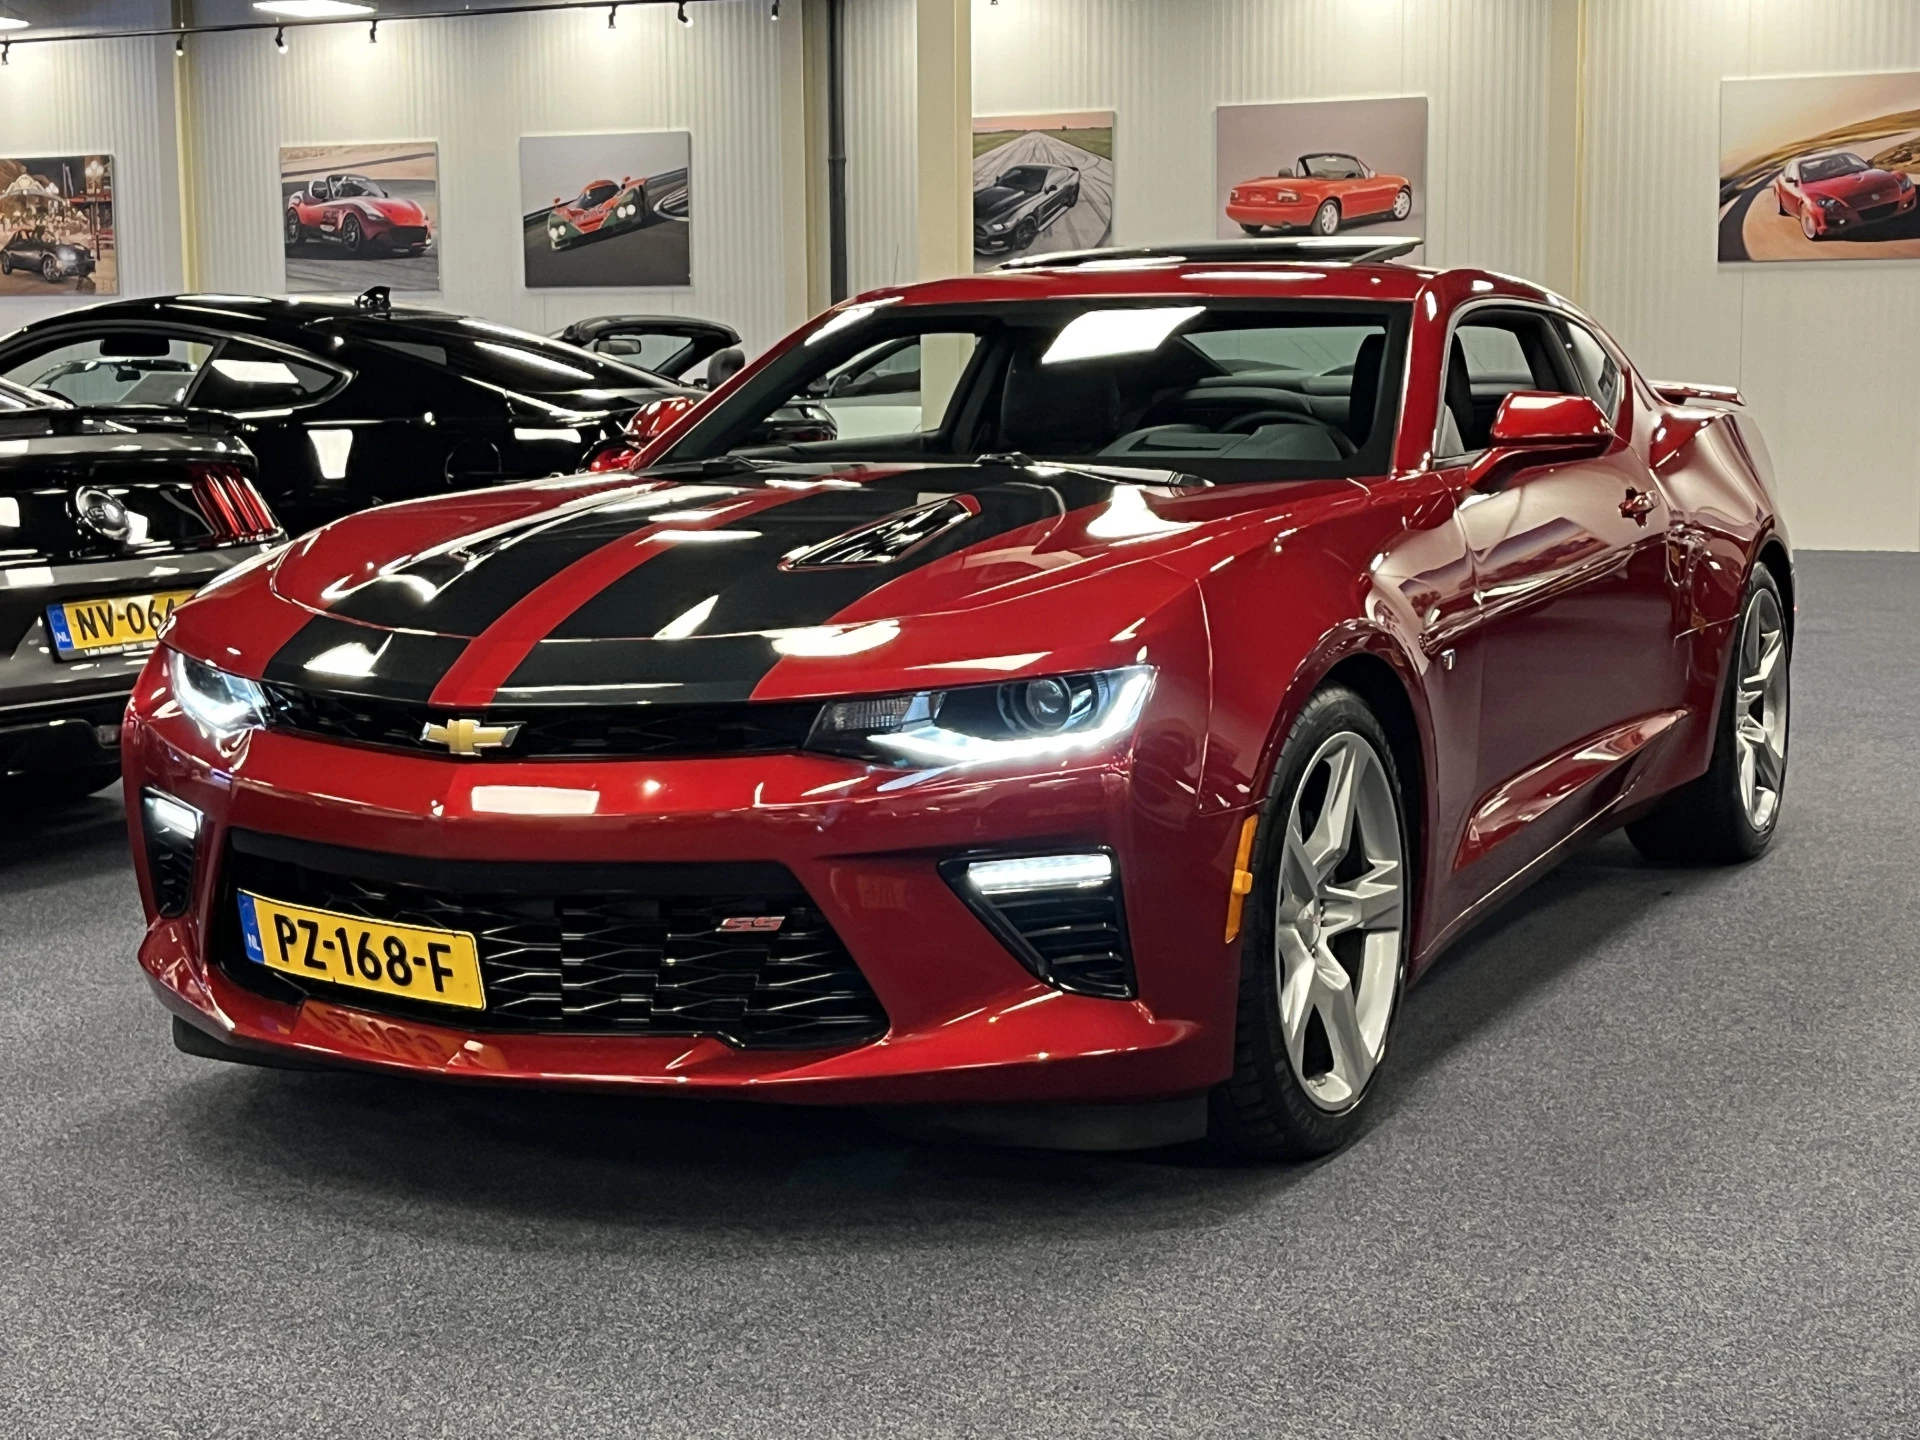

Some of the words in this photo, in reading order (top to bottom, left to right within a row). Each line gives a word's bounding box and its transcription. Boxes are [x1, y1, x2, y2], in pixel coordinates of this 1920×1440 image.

[56, 631, 70, 642] NL
[247, 933, 261, 951] NL
[273, 913, 454, 993] PZ-168-F
